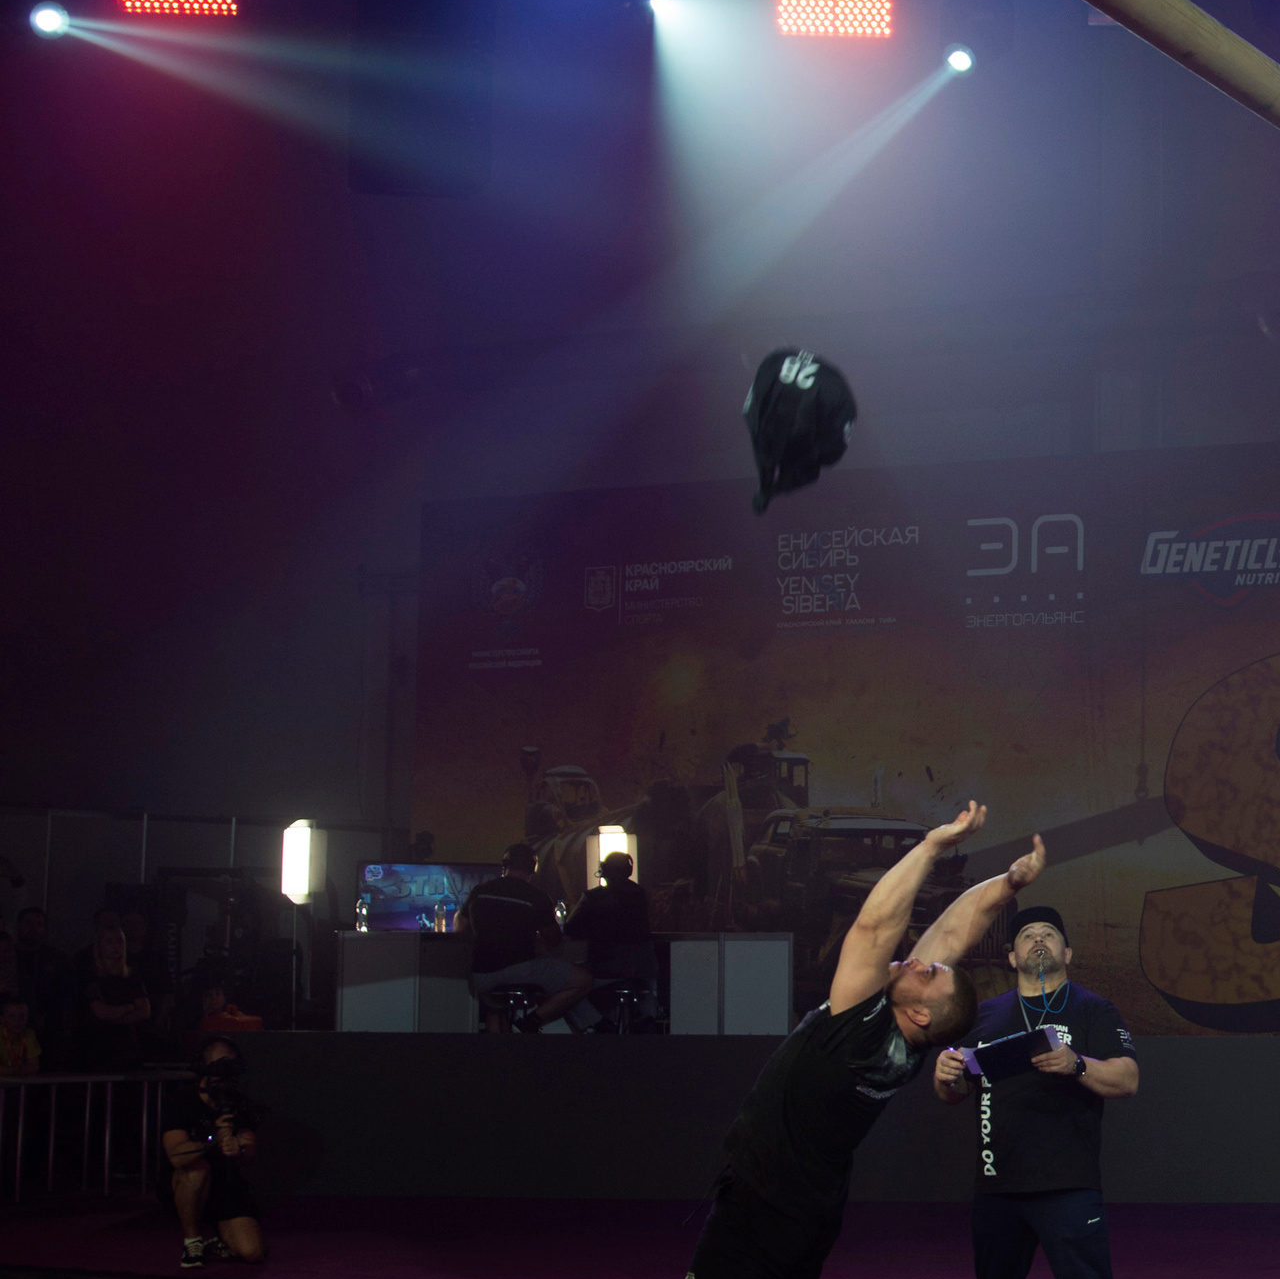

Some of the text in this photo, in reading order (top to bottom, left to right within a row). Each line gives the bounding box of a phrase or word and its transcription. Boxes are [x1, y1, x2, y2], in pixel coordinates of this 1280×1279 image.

[777, 525, 920, 553] ЕНИСЕЙСКАЯ
[625, 555, 733, 577] КРАСНОЯРСКИЙ
[777, 549, 860, 571] СИБИРЬ
[625, 576, 660, 592] КРАЙ
[776, 573, 860, 596] YENISEY
[781, 592, 861, 615] SIBERIA
[965, 610, 1086, 629] ЭНЕРГОАЛЬЯНС
[980, 1092, 993, 1145] YOUR
[981, 1148, 997, 1177] DO
